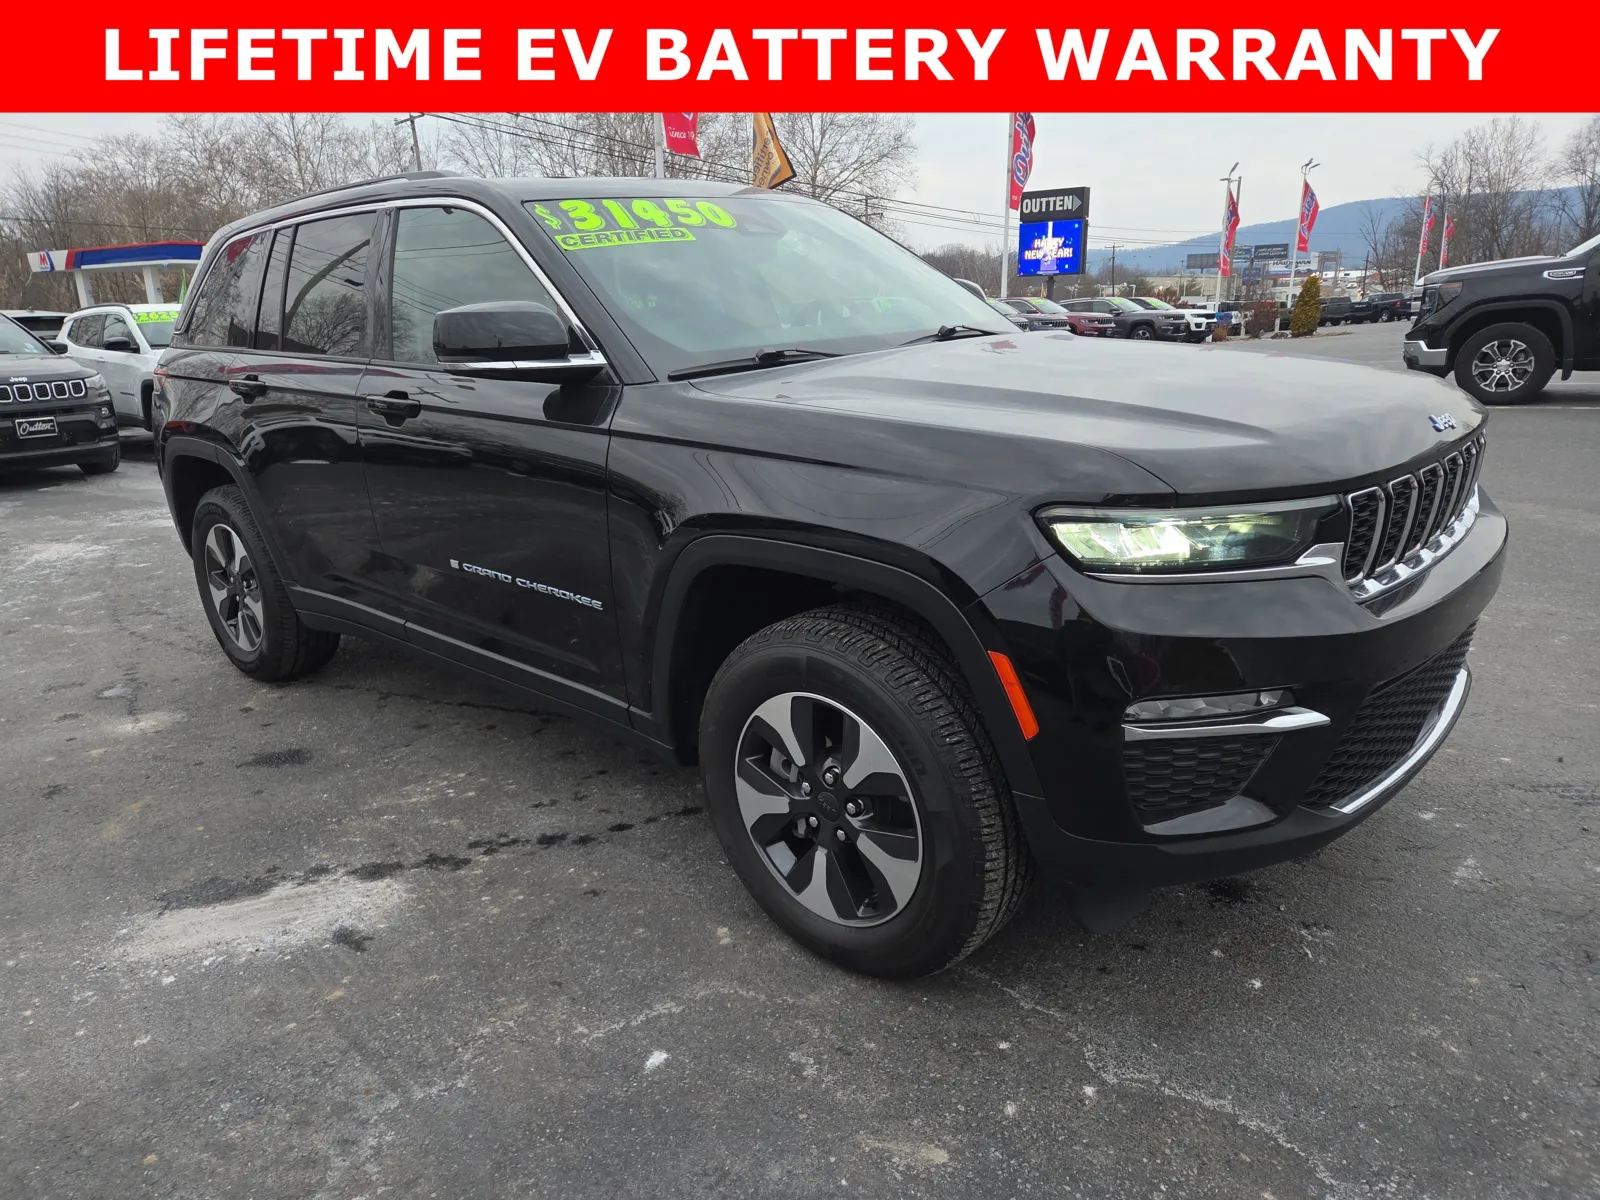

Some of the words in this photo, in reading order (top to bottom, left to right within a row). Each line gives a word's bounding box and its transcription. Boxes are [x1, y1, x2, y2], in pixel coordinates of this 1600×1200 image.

[1022, 195, 1073, 213] OUTTEN
[534, 199, 737, 231] $31450
[561, 228, 688, 247] CERTIFIED
[1428, 413, 1457, 432] Jeep
[462, 563, 512, 583] GRAND
[515, 577, 603, 610] CHEROKEE
